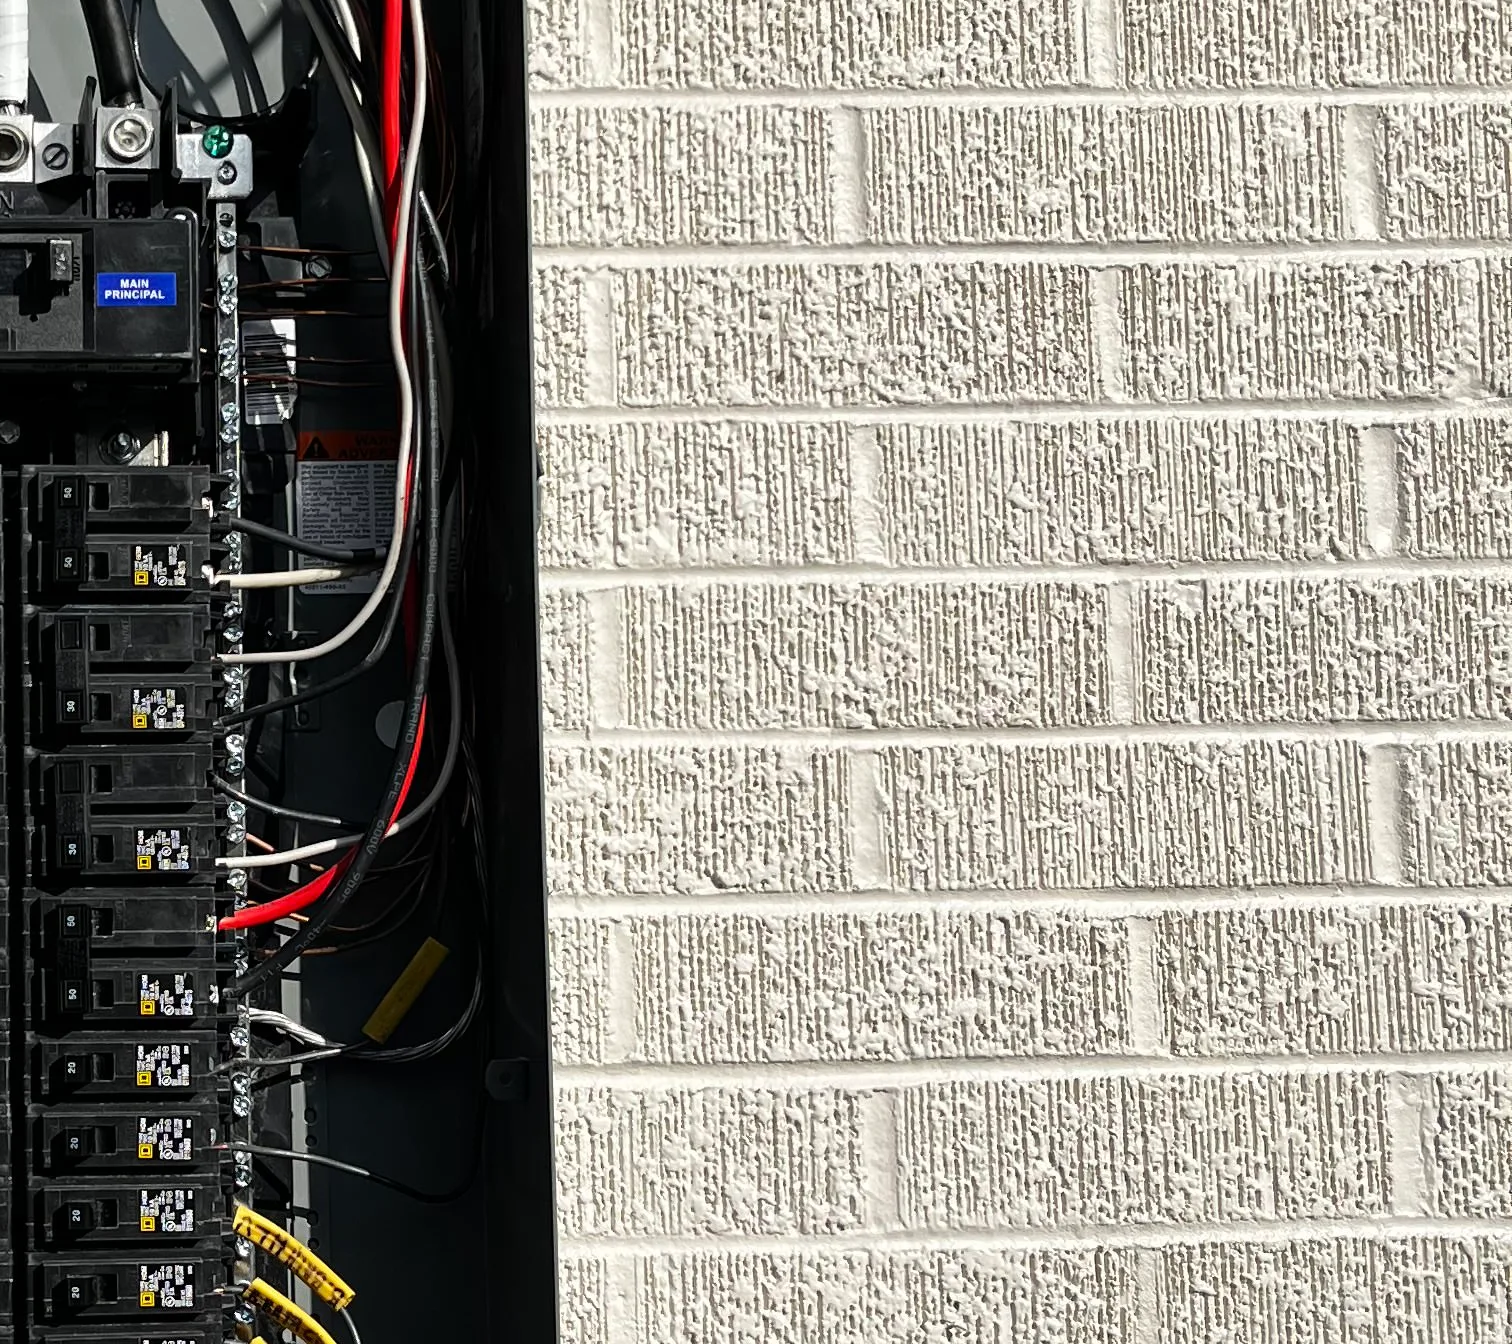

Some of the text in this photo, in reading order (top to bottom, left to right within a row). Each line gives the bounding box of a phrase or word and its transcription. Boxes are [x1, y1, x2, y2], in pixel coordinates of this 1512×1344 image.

[119, 278, 150, 289] MAIN
[104, 288, 165, 300] PRINCIPAL
[72, 1209, 81, 1222] 20
[71, 1286, 80, 1299] 20
